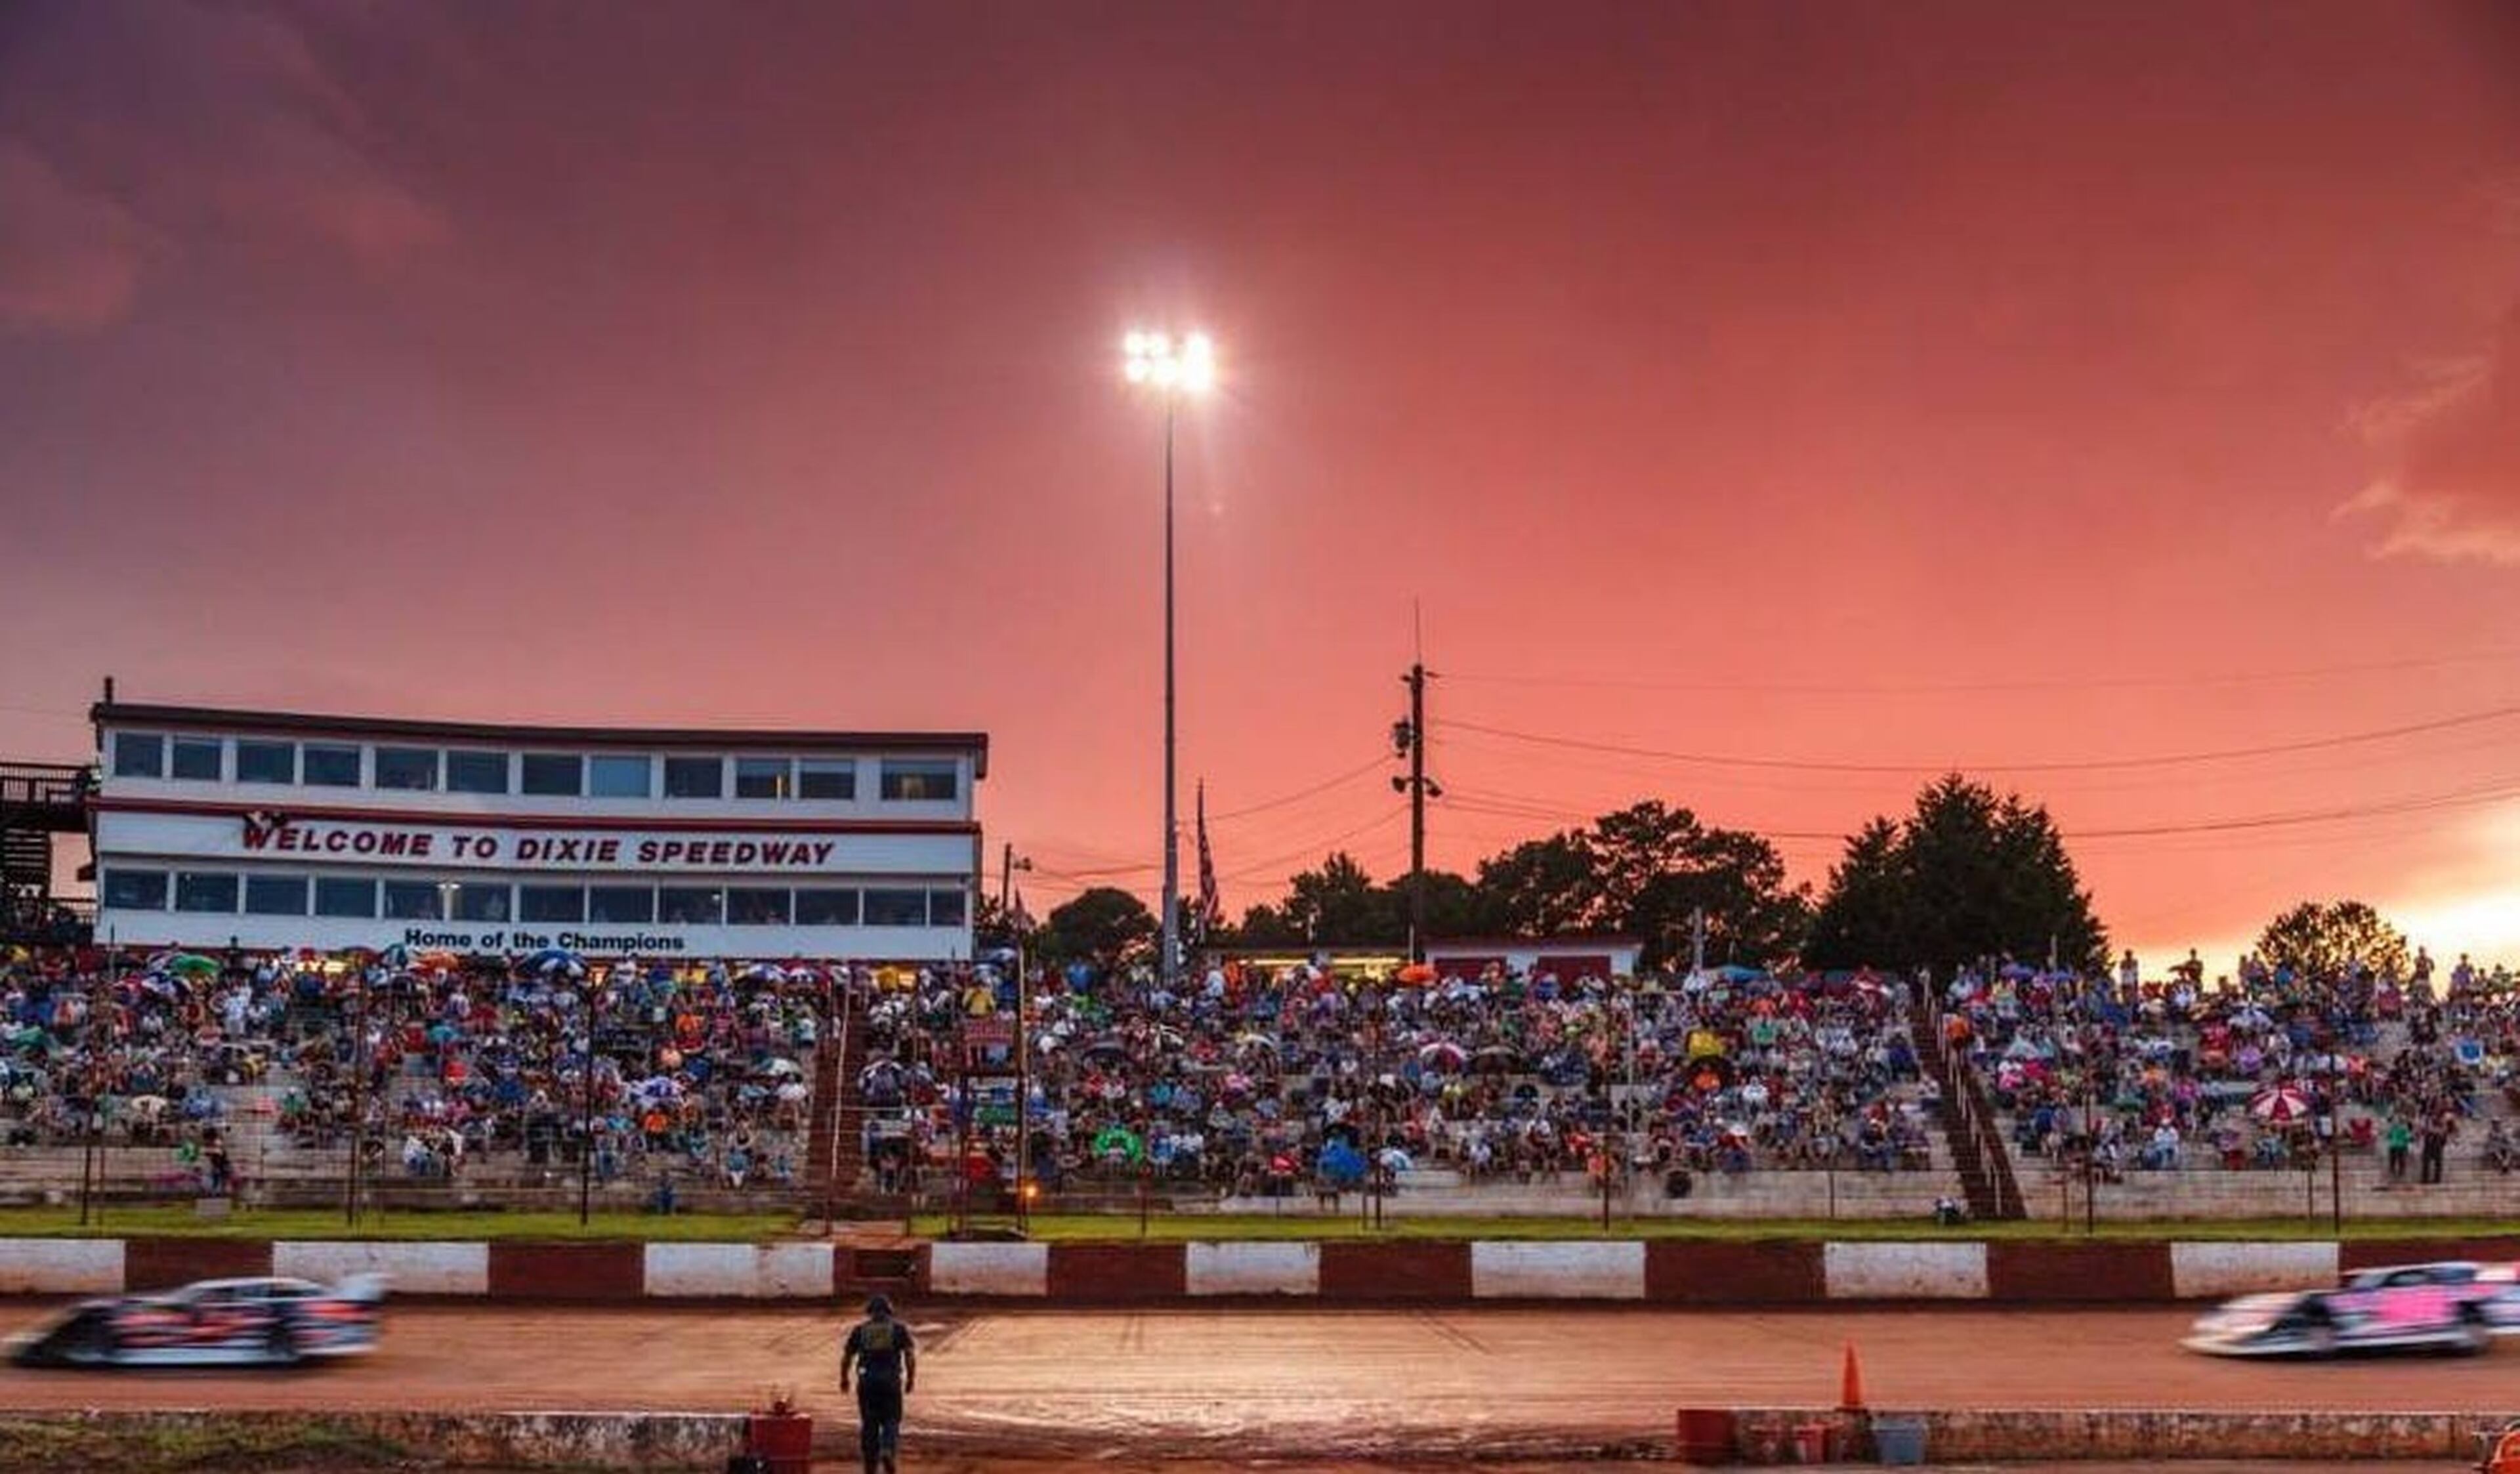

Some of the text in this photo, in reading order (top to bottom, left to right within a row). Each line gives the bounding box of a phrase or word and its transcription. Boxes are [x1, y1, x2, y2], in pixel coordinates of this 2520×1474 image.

[242, 825, 835, 866] WELCOME TO DIXIE SPEEDWAY
[405, 928, 684, 952] Home of the Champions
